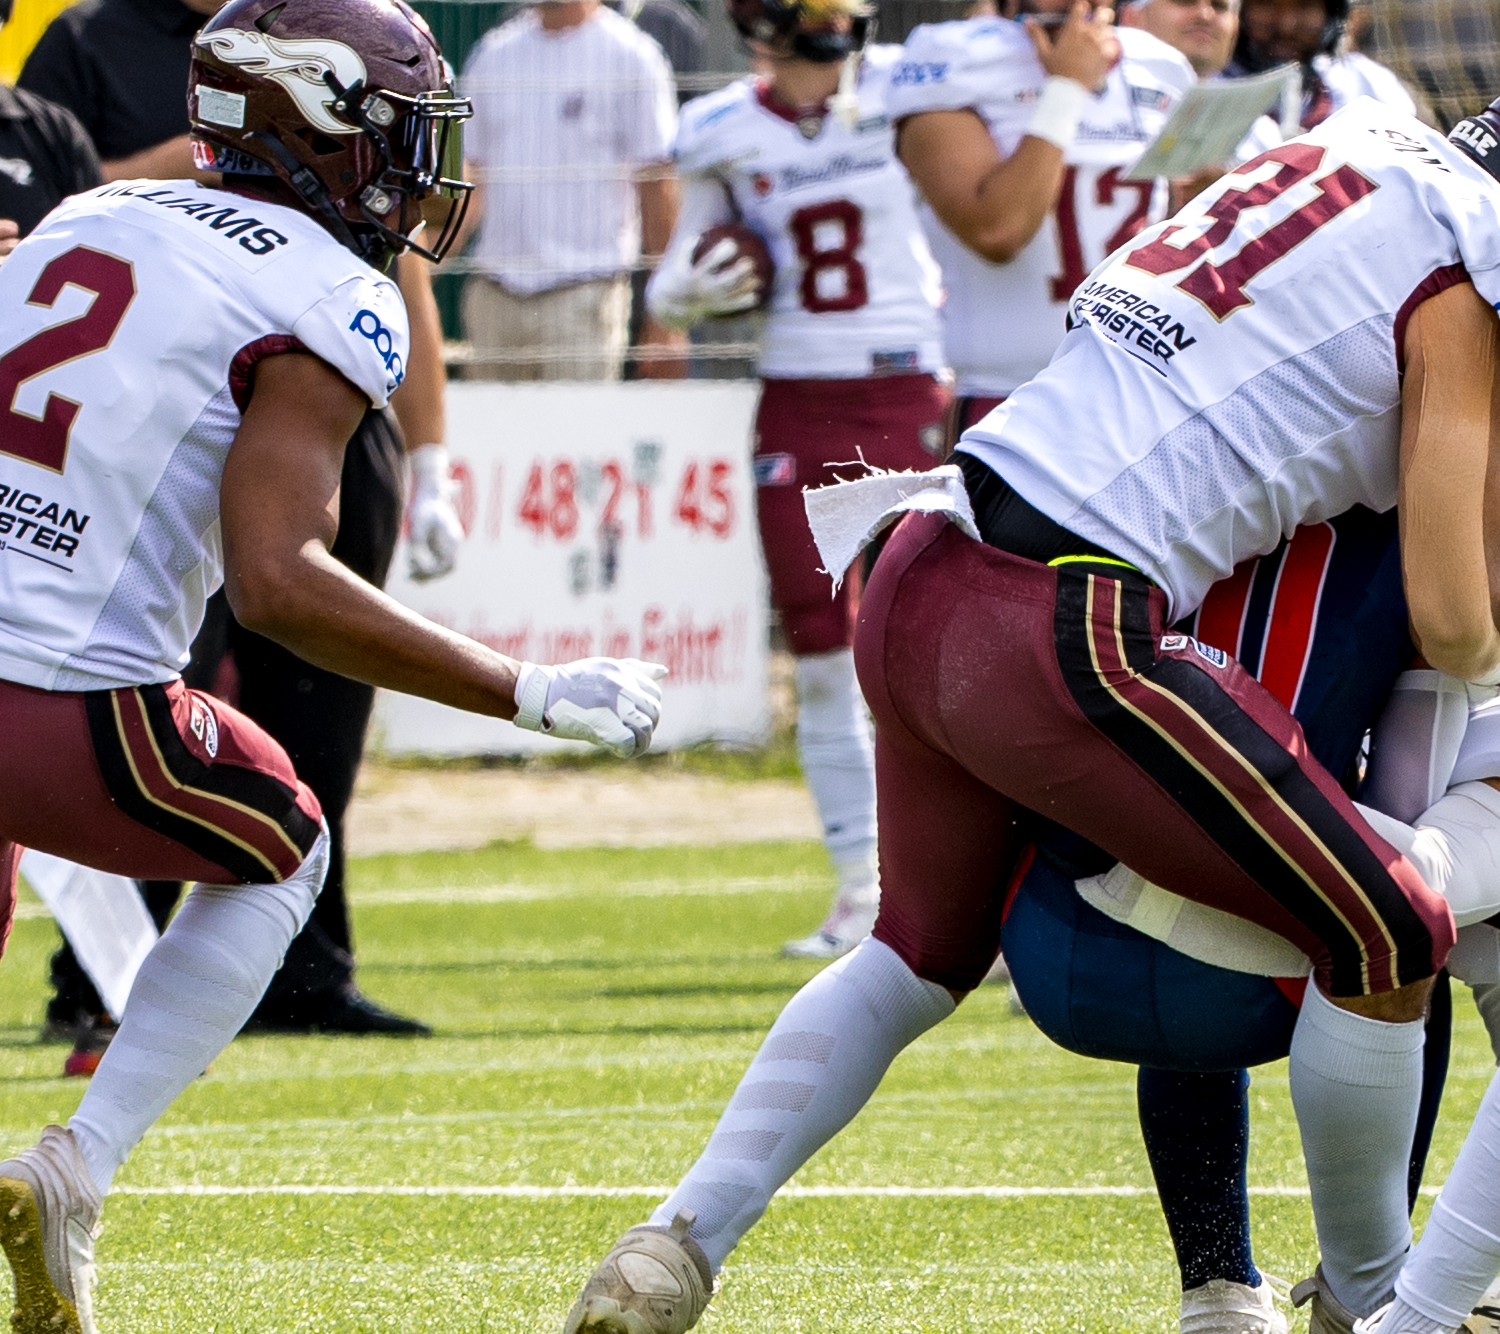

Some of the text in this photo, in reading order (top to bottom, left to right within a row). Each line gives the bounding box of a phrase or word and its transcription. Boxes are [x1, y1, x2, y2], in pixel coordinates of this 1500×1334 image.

[789, 198, 869, 314] 8
[1122, 142, 1381, 325] 31
[516, 457, 578, 541] 48
[672, 457, 737, 541] 45
